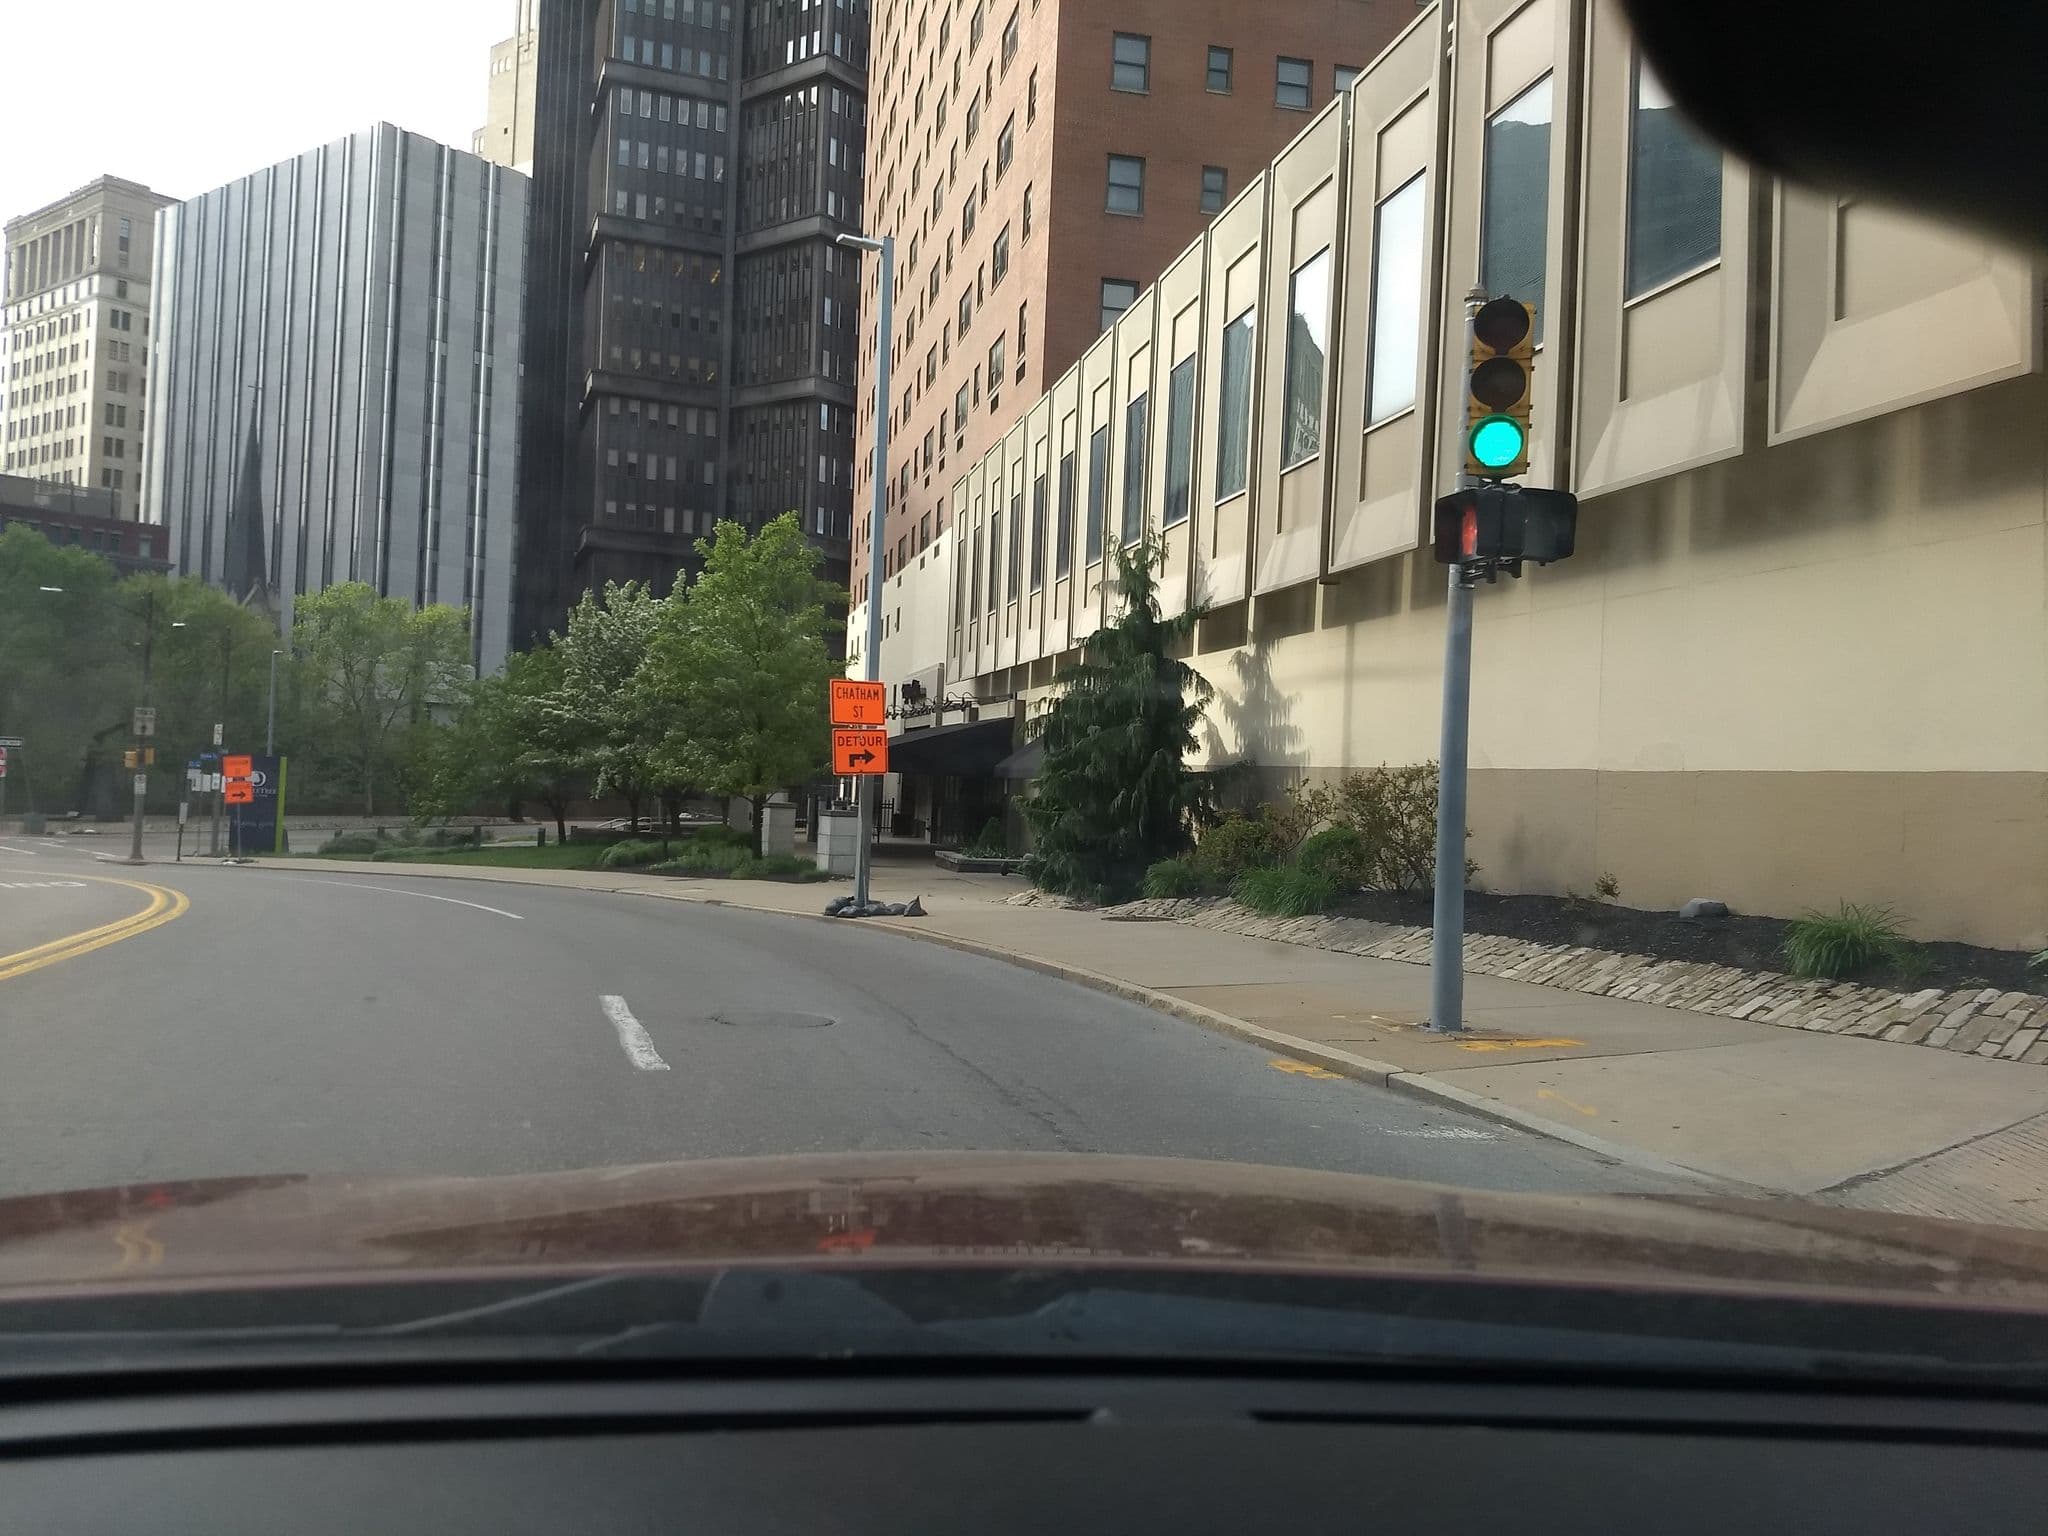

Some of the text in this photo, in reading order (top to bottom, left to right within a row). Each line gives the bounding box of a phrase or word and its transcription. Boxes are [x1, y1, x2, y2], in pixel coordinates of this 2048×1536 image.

[836, 687, 880, 700] CHATHAM
[853, 706, 864, 718] ST
[837, 736, 883, 747] DETOUR
